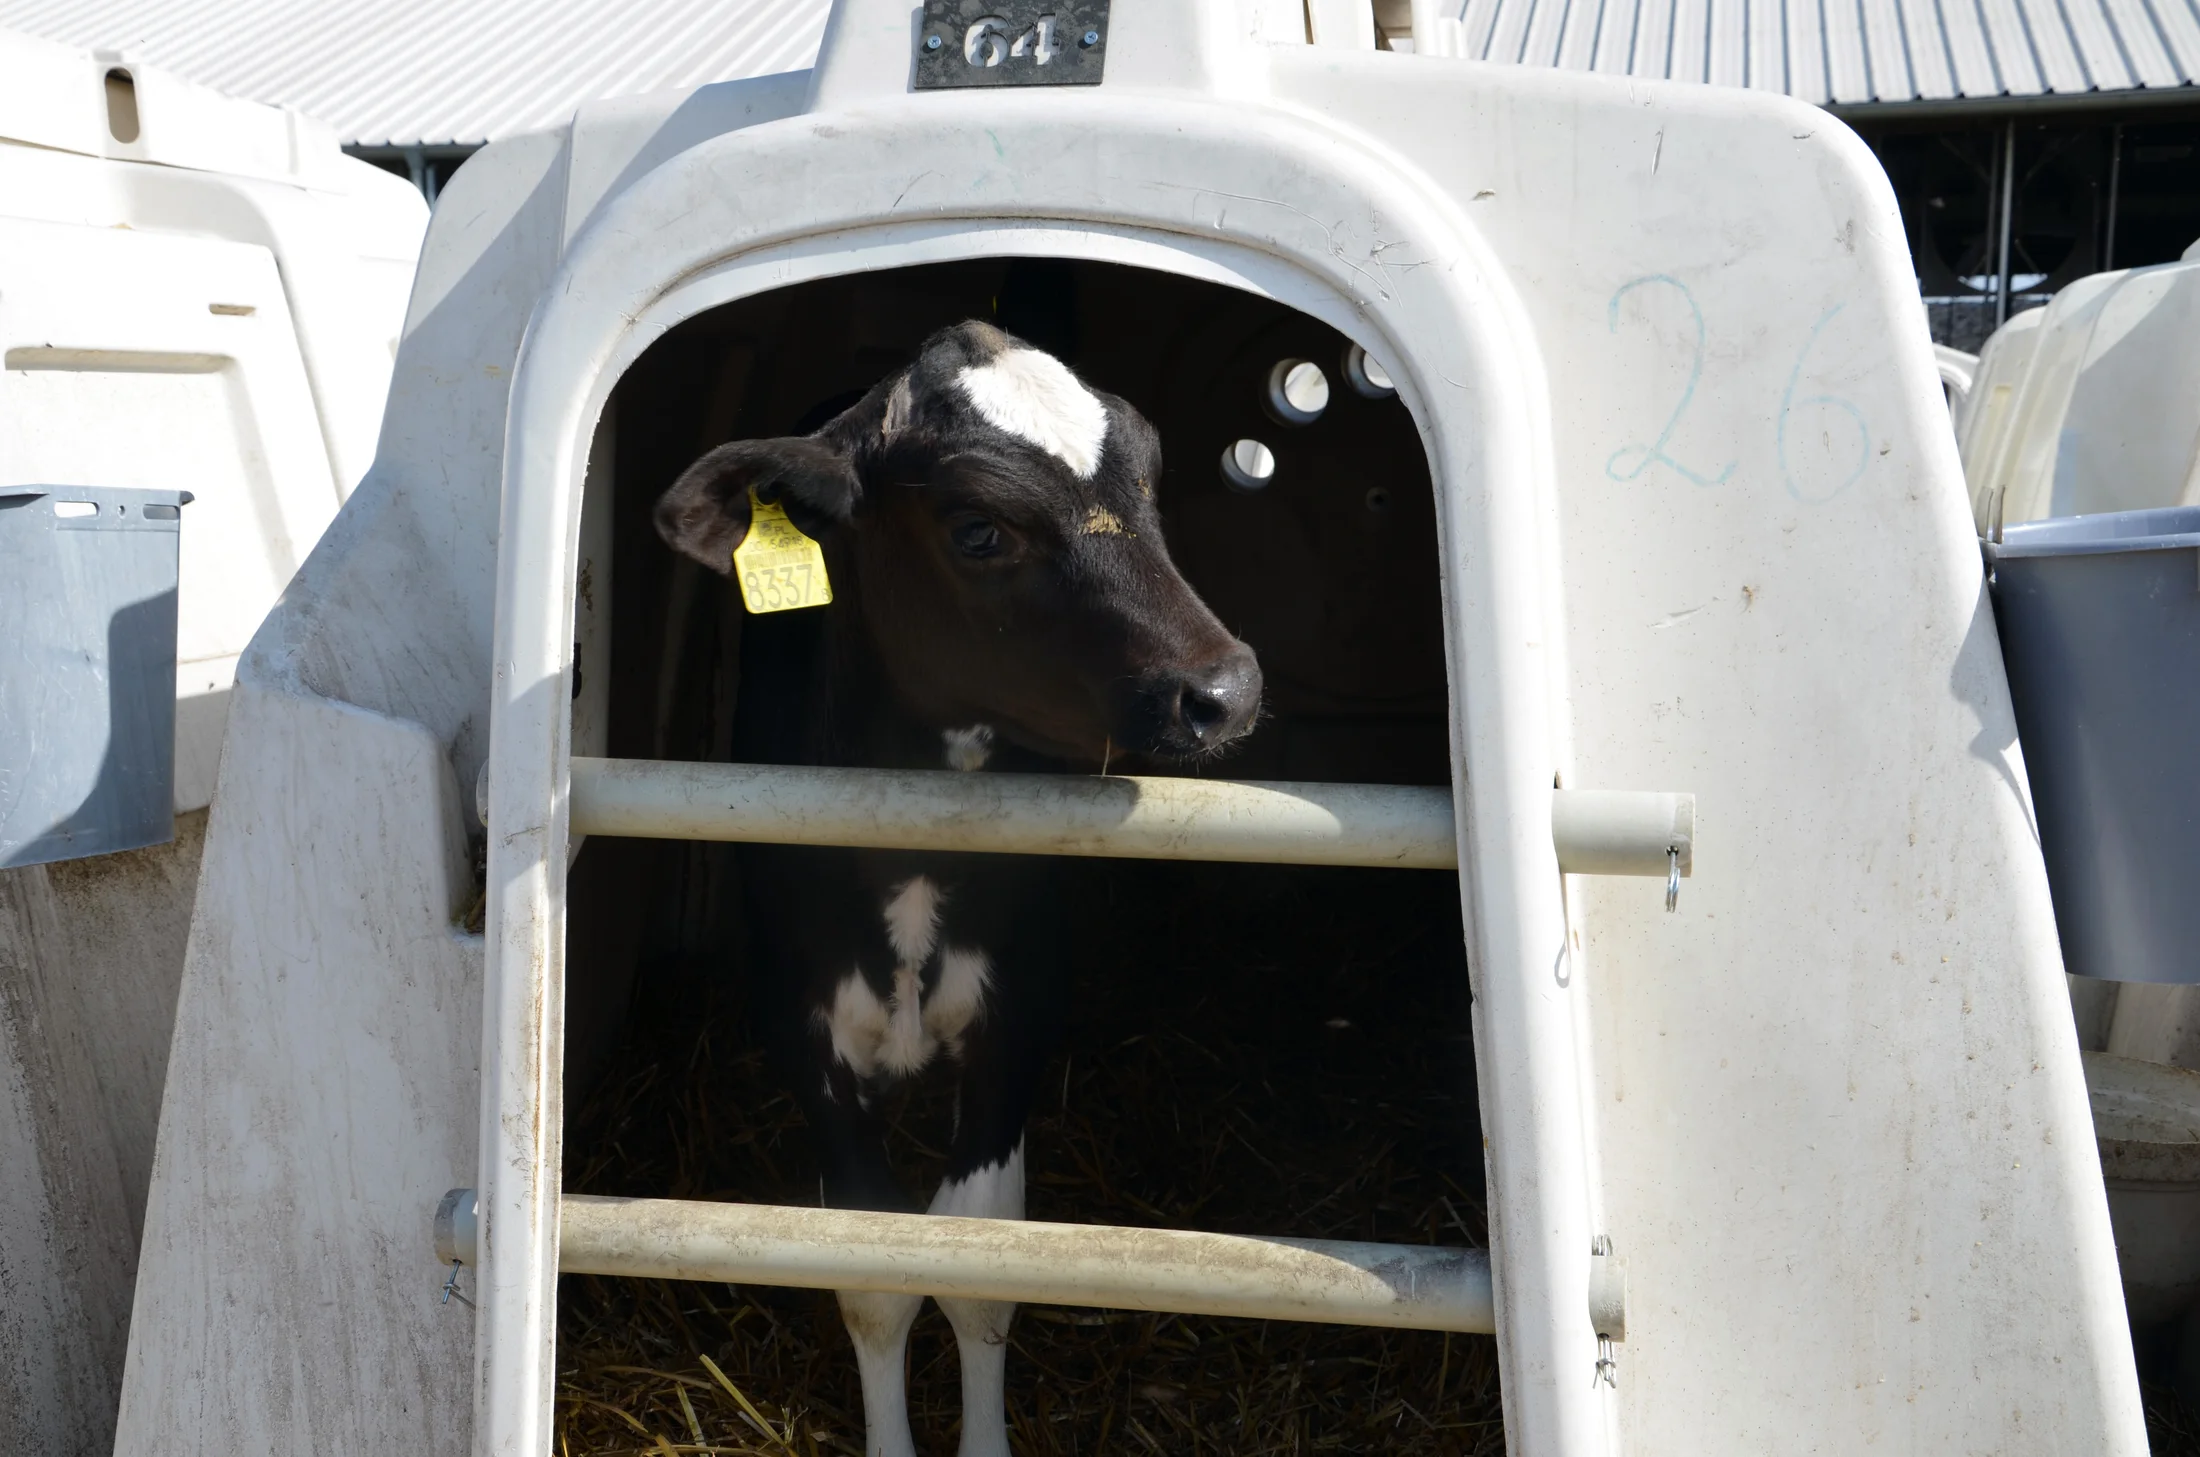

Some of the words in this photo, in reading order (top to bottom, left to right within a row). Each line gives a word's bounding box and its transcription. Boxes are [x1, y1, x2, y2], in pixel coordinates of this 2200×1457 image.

[964, 13, 1060, 67] 64
[1605, 272, 1872, 504] 26
[773, 525, 789, 536] PL
[745, 564, 813, 612] 8337
